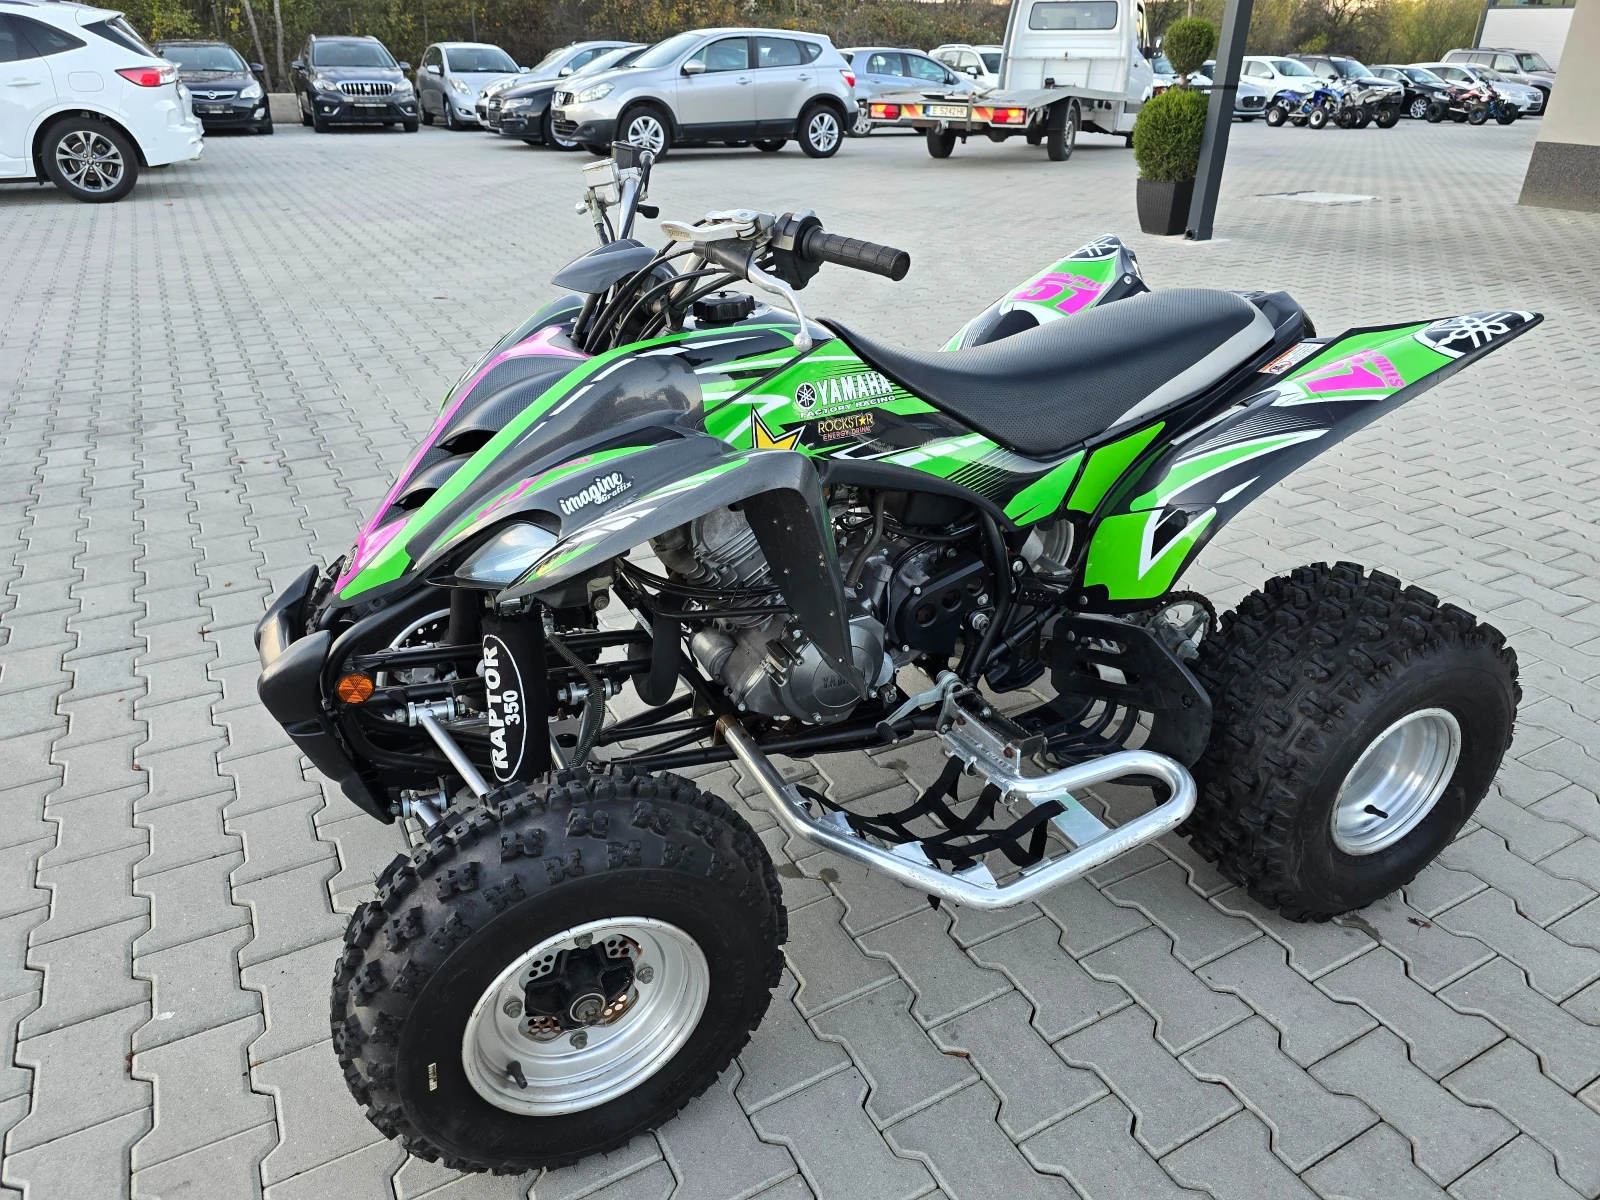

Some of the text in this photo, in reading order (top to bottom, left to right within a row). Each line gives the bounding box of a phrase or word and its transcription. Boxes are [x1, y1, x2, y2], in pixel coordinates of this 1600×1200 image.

[816, 372, 893, 406] YAMAHA
[800, 395, 896, 419] FACTORY RACING
[823, 426, 871, 441] ENERGY DRINK
[559, 472, 623, 515] imagine
[600, 480, 633, 503] Graffix
[485, 645, 509, 769] RAPTOR
[502, 690, 521, 726] 350
